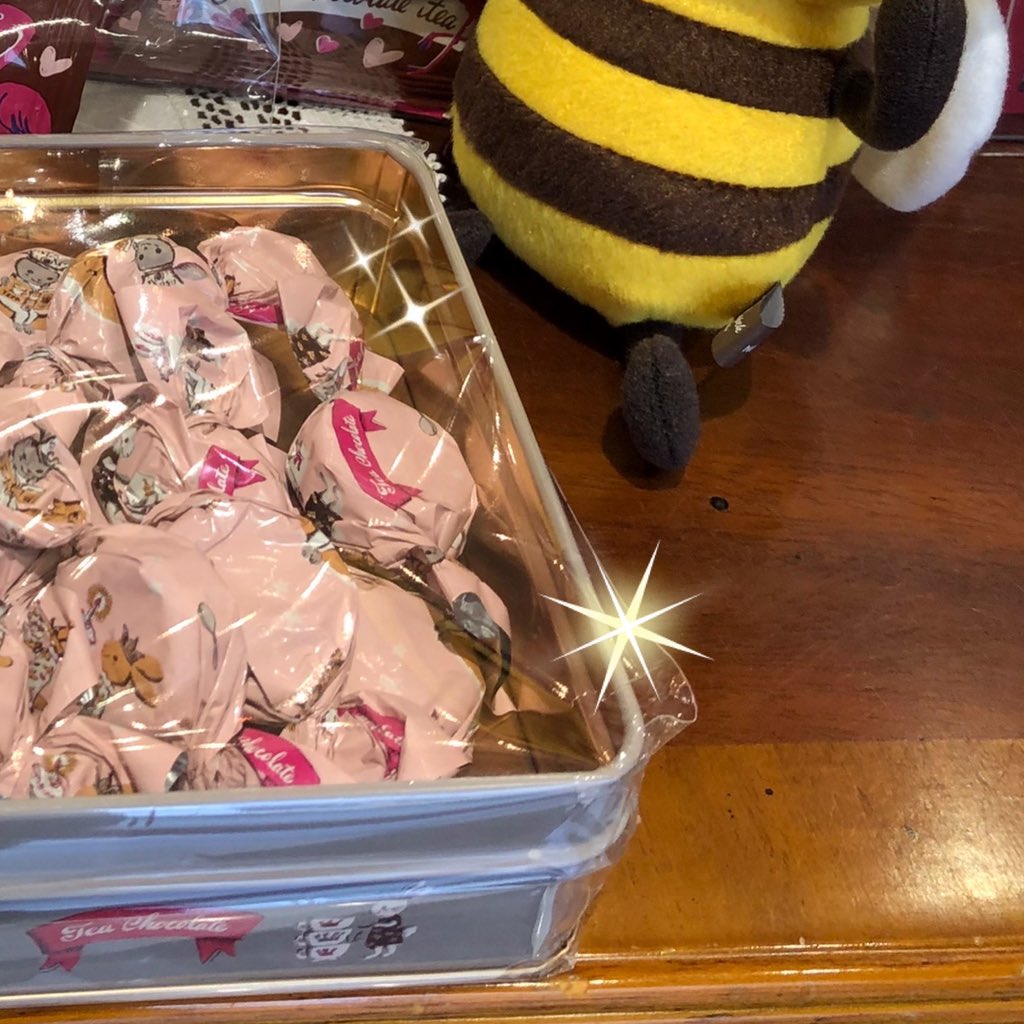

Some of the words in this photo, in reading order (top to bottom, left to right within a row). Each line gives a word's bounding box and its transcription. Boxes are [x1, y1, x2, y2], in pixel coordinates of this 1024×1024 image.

[416, 0, 460, 31] tea
[60, 922, 114, 943] Tea
[122, 912, 229, 934] Chocolate
